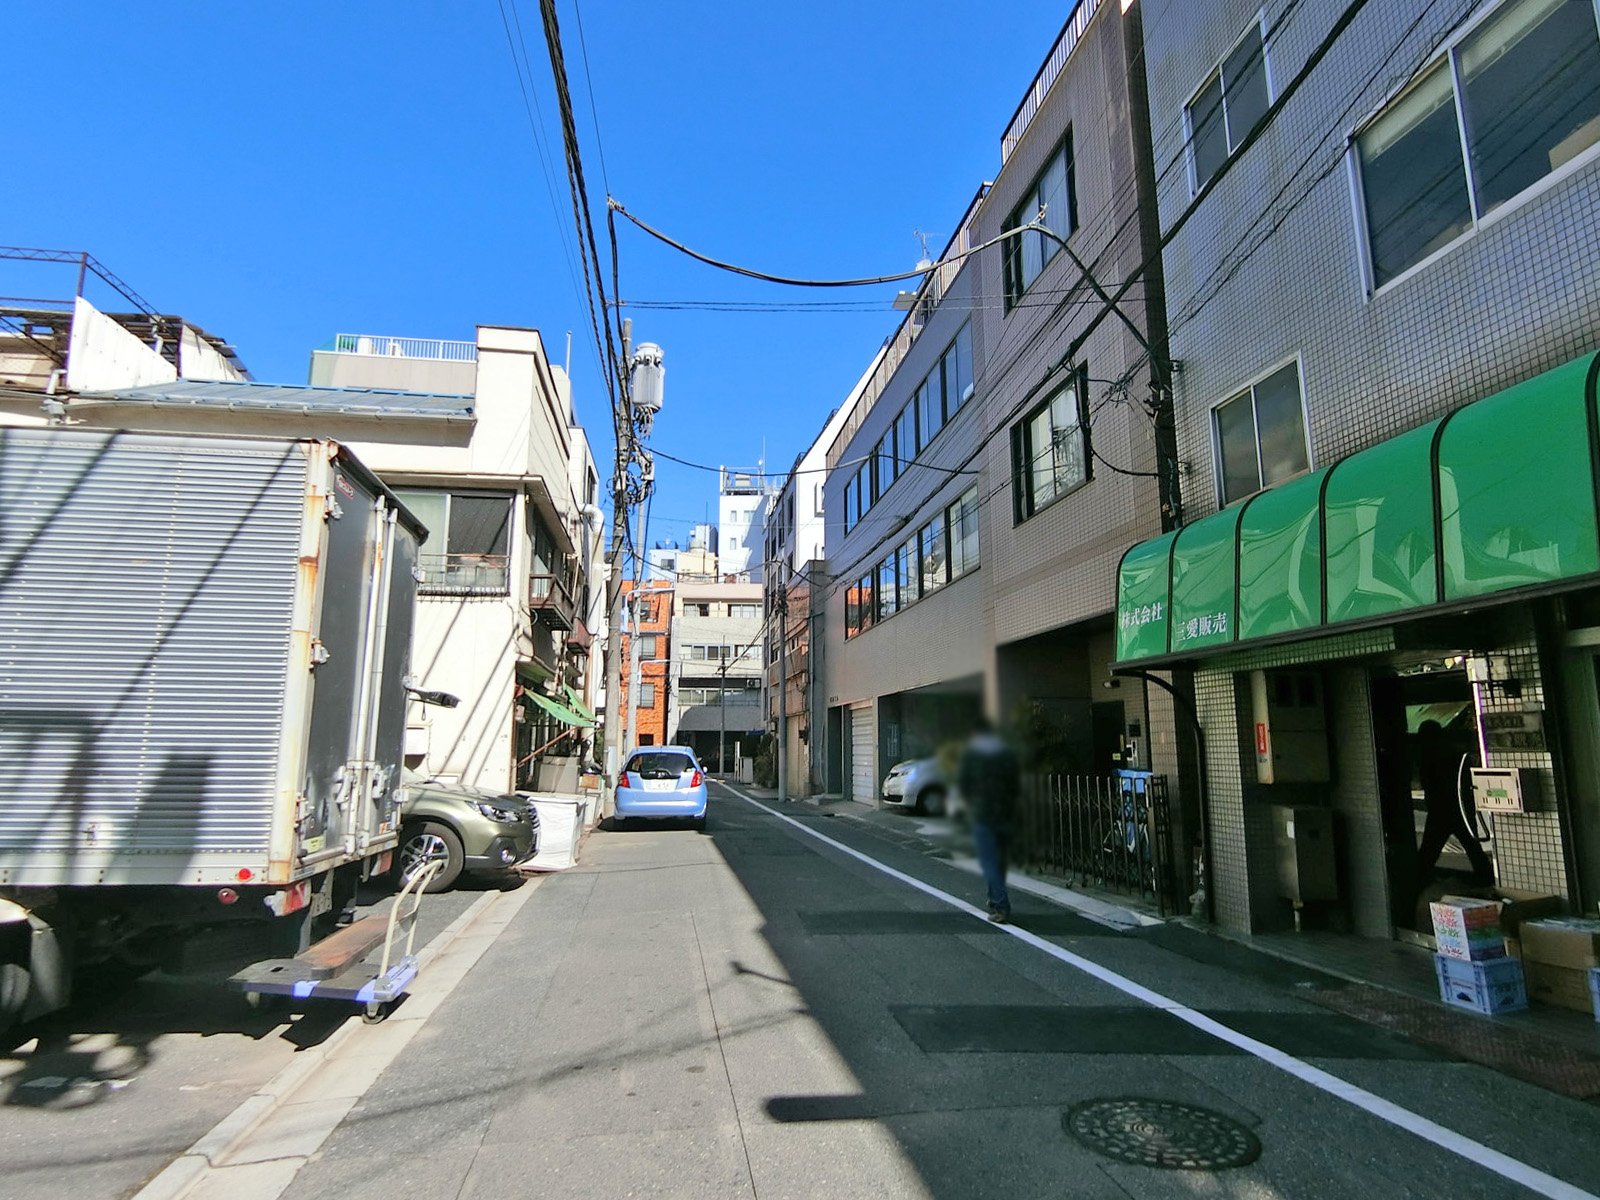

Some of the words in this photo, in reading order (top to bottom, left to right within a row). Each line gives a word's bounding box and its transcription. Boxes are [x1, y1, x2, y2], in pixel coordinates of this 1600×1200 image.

[1121, 602, 1163, 629] 株式会社
[1176, 612, 1227, 641] 三愛販売
